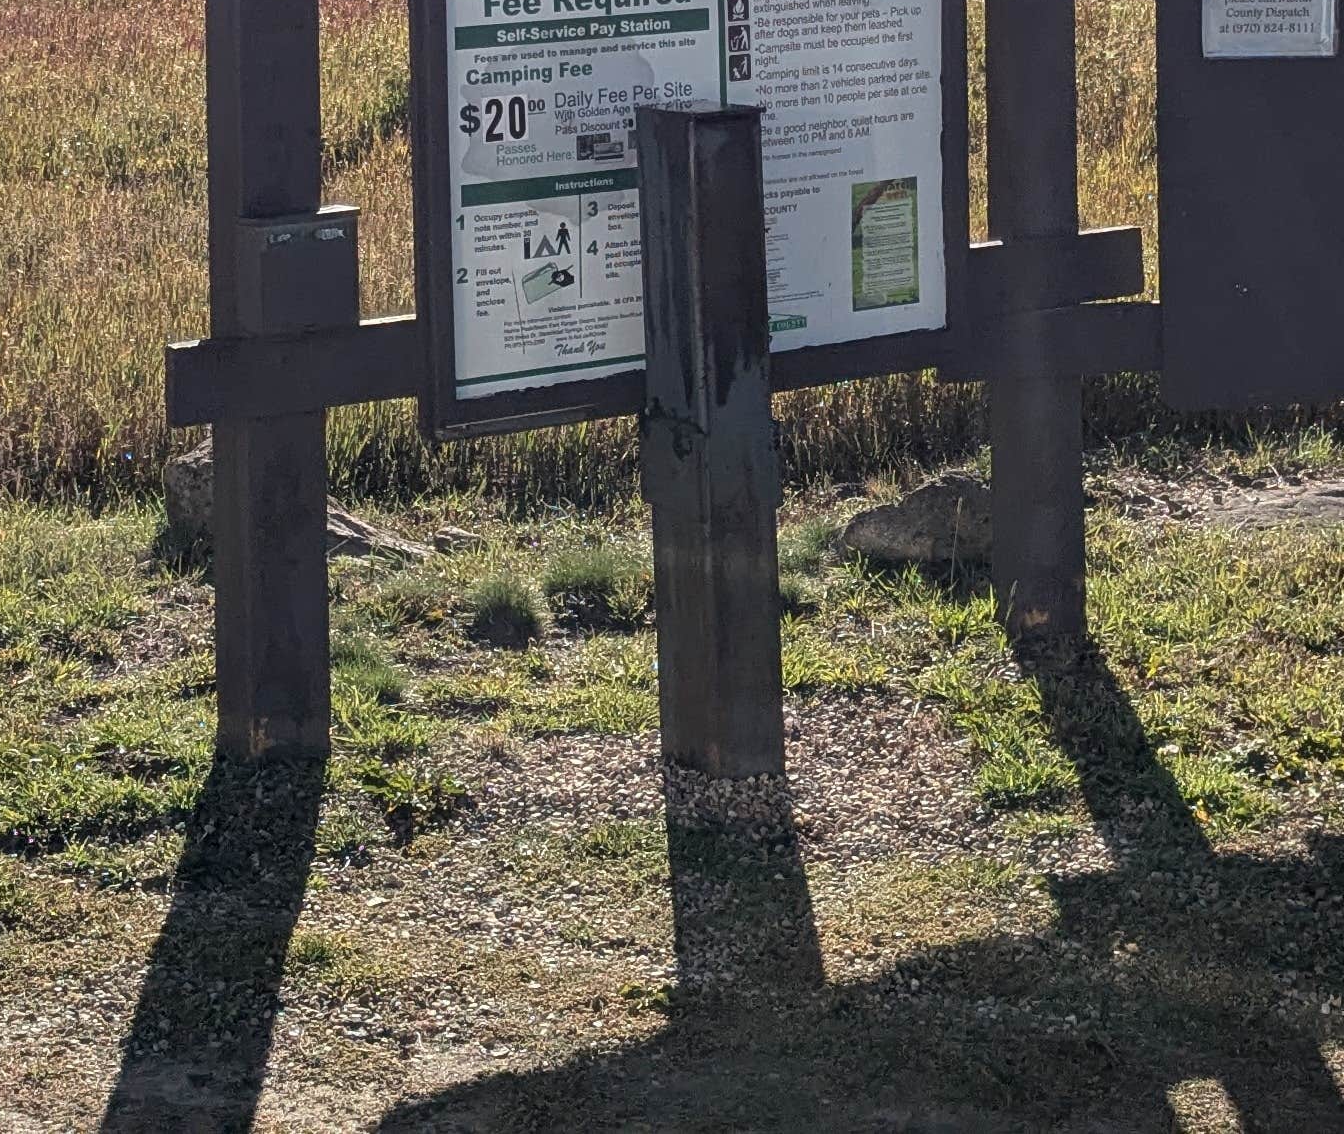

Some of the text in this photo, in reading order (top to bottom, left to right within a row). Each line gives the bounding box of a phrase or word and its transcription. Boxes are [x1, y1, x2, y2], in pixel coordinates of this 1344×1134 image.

[754, 0, 809, 14] extinguished
[1226, 7, 1309, 19] County Dispatch
[773, 13, 823, 27] responsible
[826, 13, 837, 22] for
[840, 12, 859, 23] your
[862, 10, 880, 20] pets
[890, 7, 907, 17] Pick
[910, 7, 921, 16] up
[496, 19, 671, 42] Self-Service Pay Station
[755, 23, 866, 40] after dogs and keep them
[1219, 23, 1314, 34] at (970) 824-8111
[474, 38, 695, 63] Fees are used to manage and service this site
[759, 43, 801, 55] Campsite
[803, 40, 825, 50] must
[827, 39, 838, 48] be
[841, 34, 880, 47] occupied
[882, 33, 895, 43] the
[466, 62, 593, 86] Camping Fee
[759, 60, 896, 82] Camping limit is 14 consecutive
[759, 73, 912, 95] No more than 2 vehicles parked per
[555, 82, 692, 109] Daily Fee Per Site
[459, 96, 526, 142] $20
[555, 105, 631, 119] With Golden Age
[555, 121, 620, 135] Pass Discount
[496, 143, 536, 155] Passes
[496, 150, 575, 166] Honored Here:
[556, 177, 614, 191] Instructions
[781, 186, 810, 199] payable
[588, 201, 598, 217] 3
[765, 205, 797, 215] COUNTY
[456, 215, 464, 230] 1
[586, 240, 598, 255] 4
[456, 268, 468, 284] 2
[554, 343, 584, 356] Thank
[587, 339, 606, 355] You
